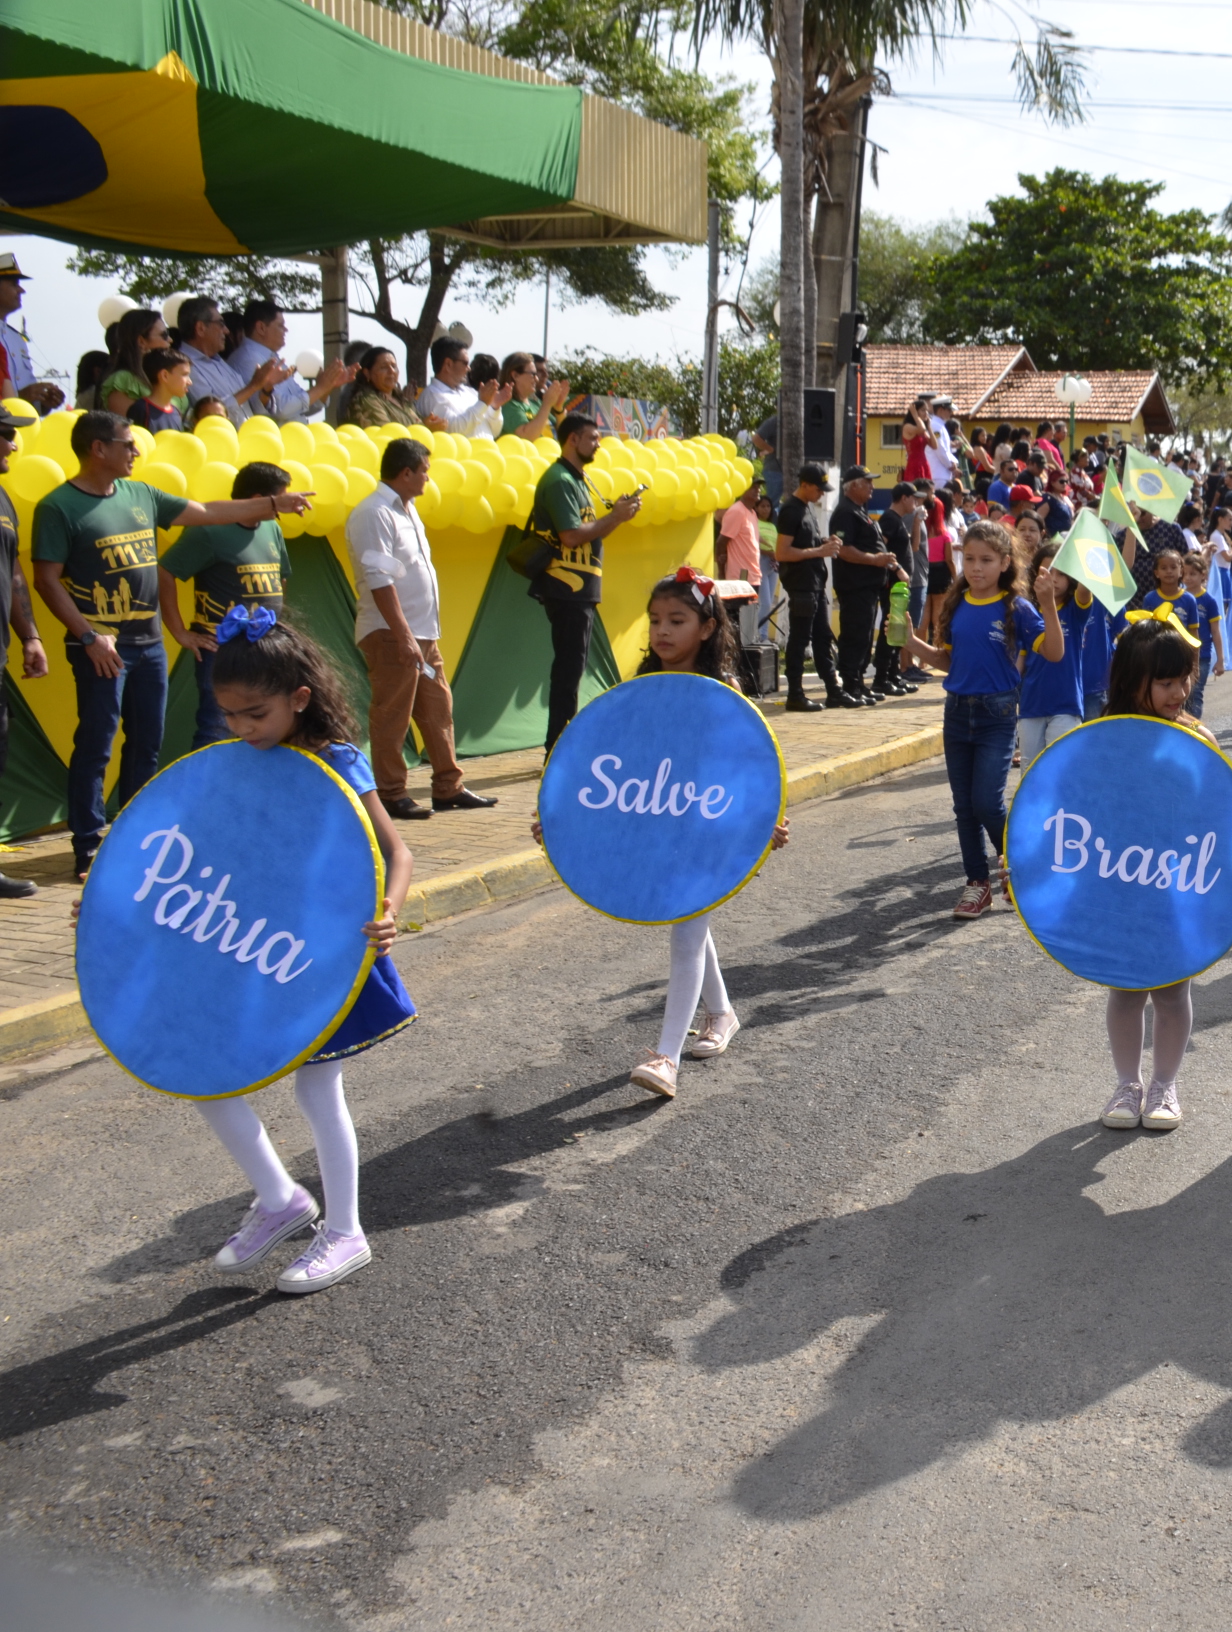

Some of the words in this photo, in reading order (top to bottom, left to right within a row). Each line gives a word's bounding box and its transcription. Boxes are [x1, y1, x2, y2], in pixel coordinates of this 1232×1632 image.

[101, 543, 139, 569] 111
[241, 573, 273, 593] 111
[578, 753, 734, 820] Salve
[1043, 808, 1222, 895] Brasil
[134, 824, 313, 984] Pátria
